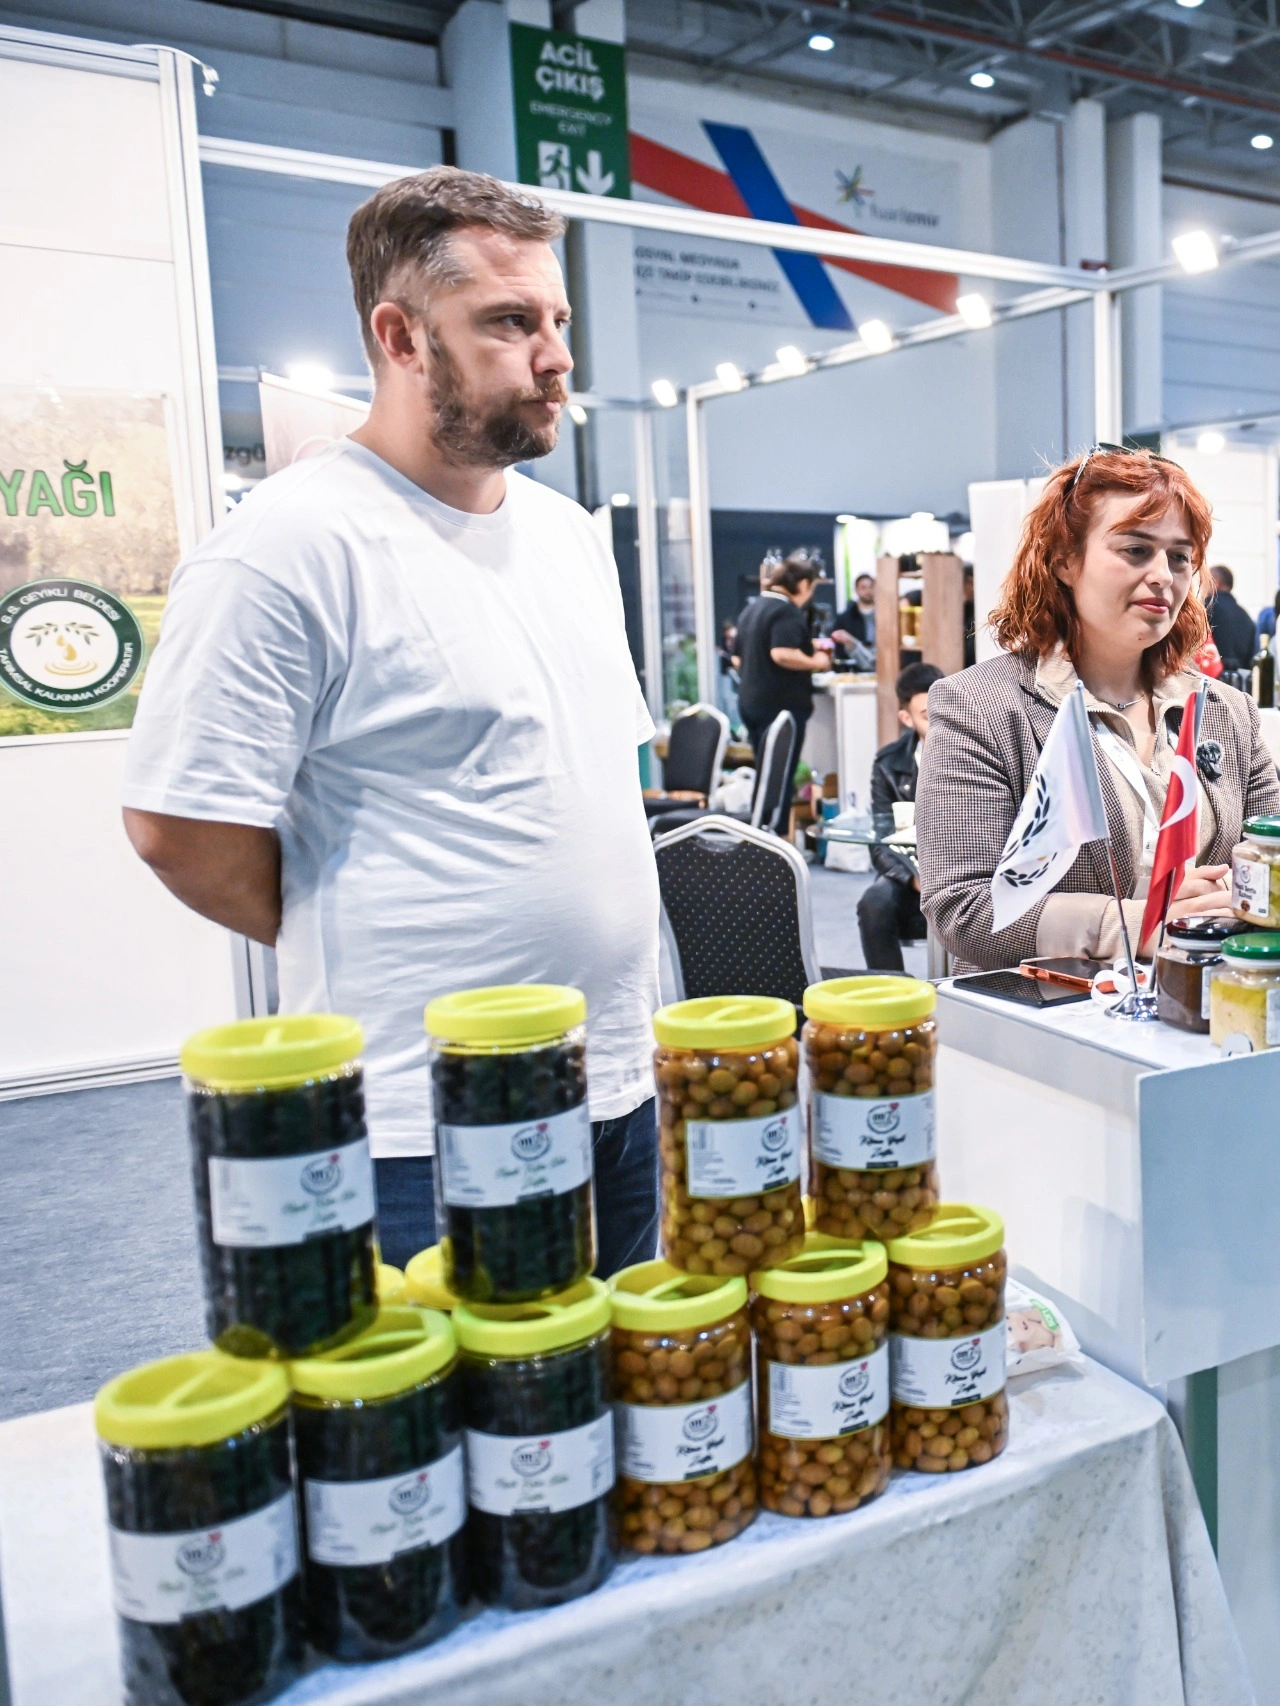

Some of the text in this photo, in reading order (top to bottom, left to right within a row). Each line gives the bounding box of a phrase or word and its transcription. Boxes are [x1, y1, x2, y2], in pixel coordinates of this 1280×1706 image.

[540, 41, 599, 72] ACİL
[535, 65, 605, 101] ÇIKIŞ
[0, 459, 116, 518] YAĞI
[35, 687, 95, 702] KALKINMA
